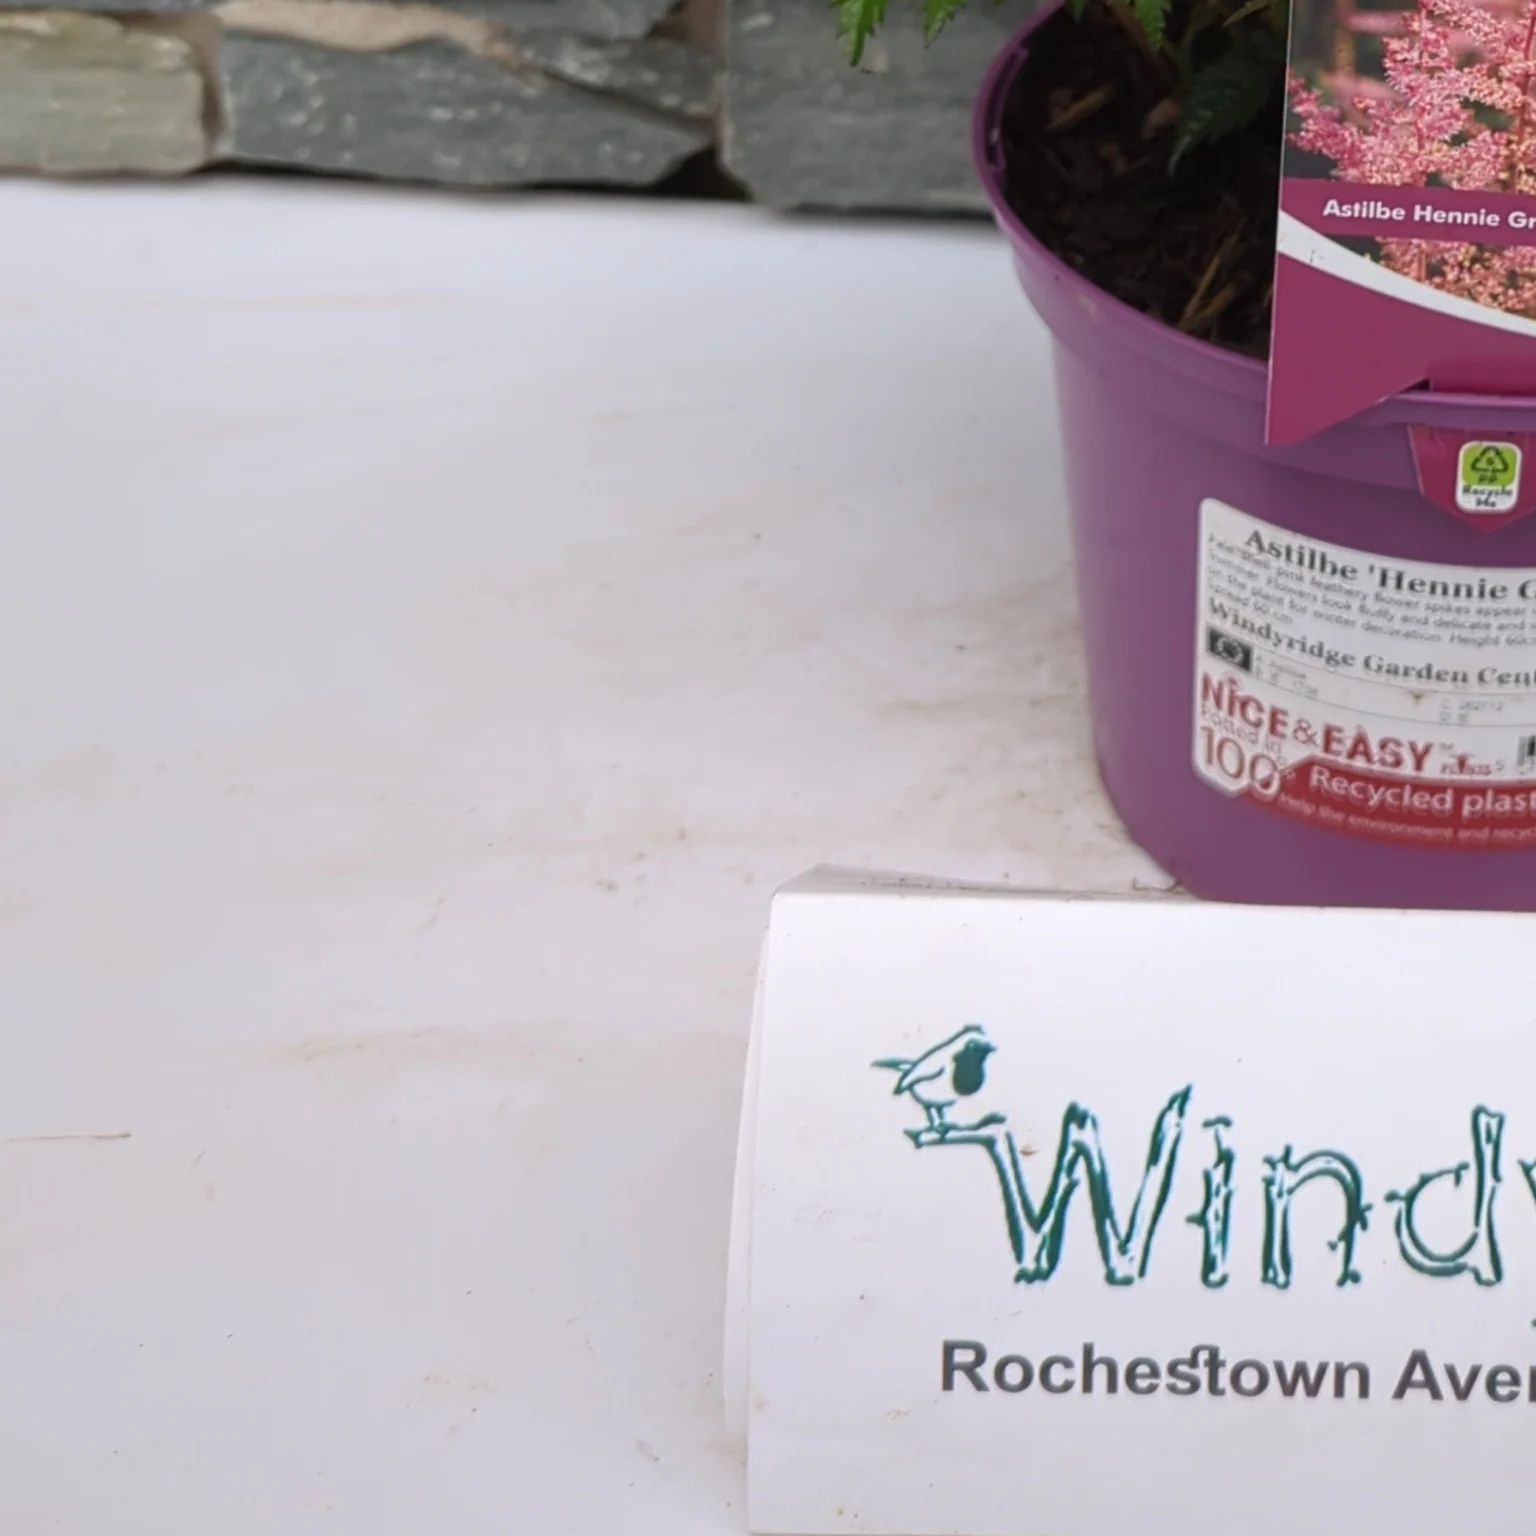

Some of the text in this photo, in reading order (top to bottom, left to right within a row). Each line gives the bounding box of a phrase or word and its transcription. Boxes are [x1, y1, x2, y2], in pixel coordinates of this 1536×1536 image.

[1322, 199, 1406, 220] Astilbe
[1413, 204, 1500, 227] Hennie
[1245, 530, 1358, 581] Astilbe
[1369, 564, 1508, 599] 'Hennie
[1208, 597, 1356, 667] Windyridge
[1363, 654, 1468, 684] Garden
[1309, 764, 1453, 812] Recycled
[941, 1341, 1371, 1401] Rochestown
